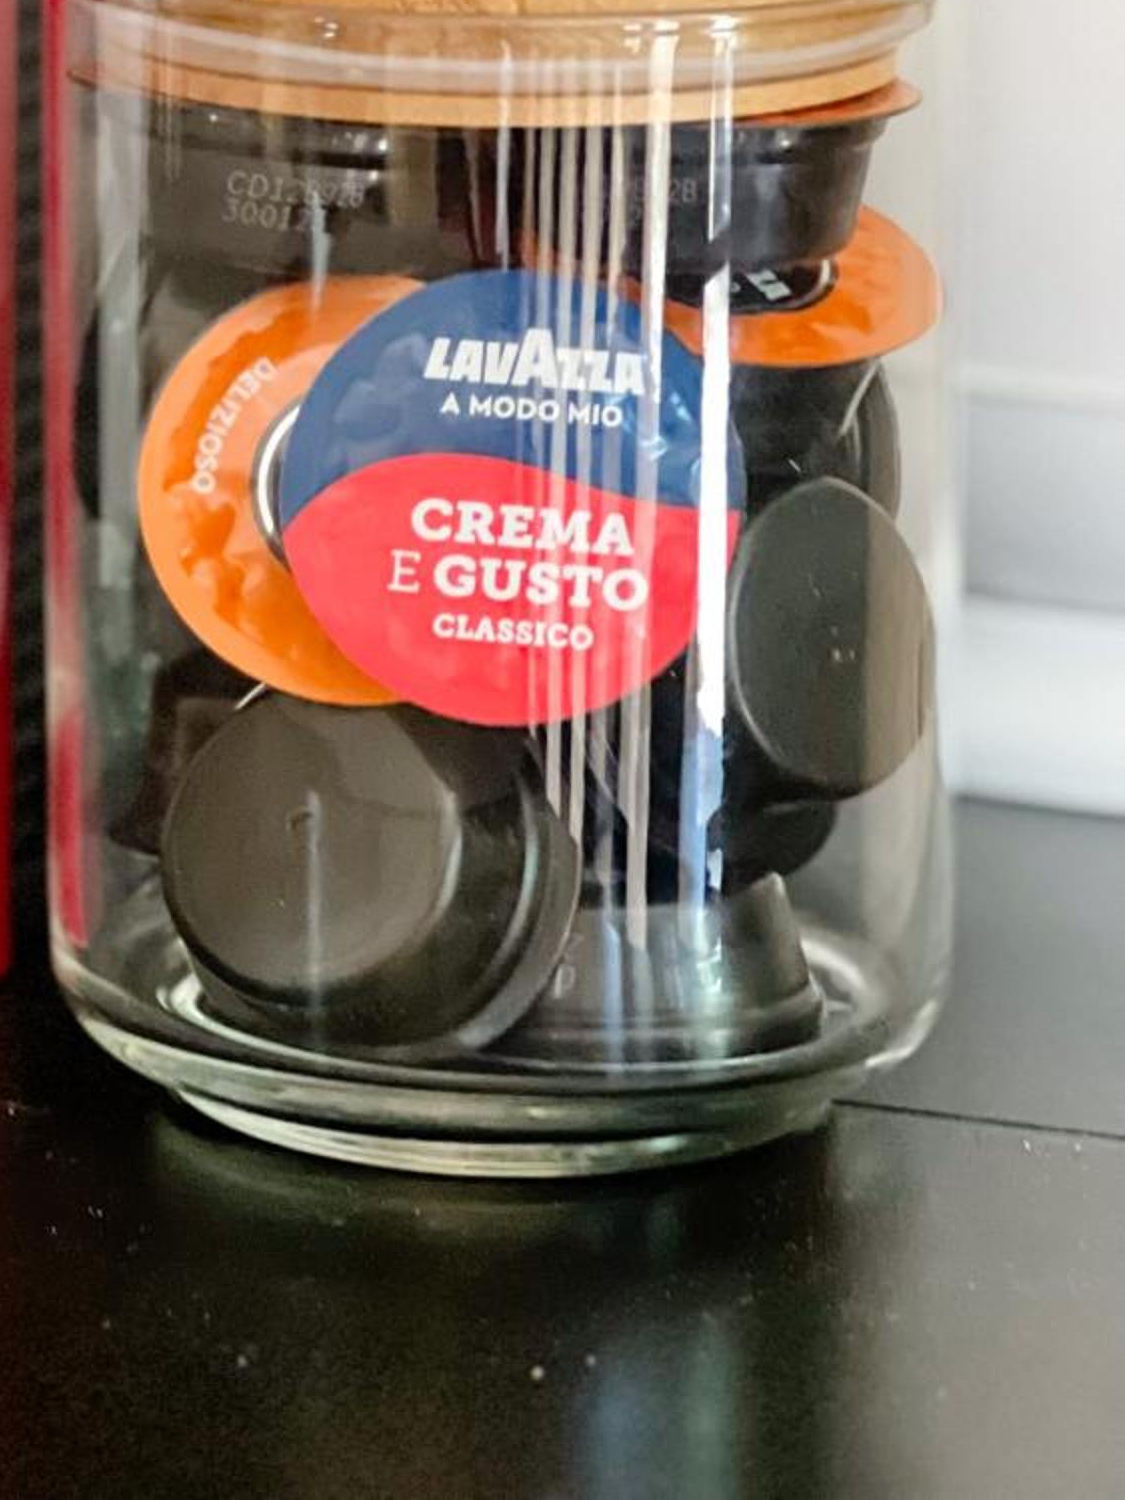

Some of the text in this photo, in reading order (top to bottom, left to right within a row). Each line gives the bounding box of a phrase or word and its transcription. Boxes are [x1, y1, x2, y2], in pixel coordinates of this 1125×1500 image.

[423, 327, 646, 396] LAVAZZA
[191, 357, 278, 495] DELIZIOSO
[439, 392, 624, 428] A MODO MIO
[411, 497, 635, 556] CREMA
[387, 548, 649, 612] E GUSTO
[432, 612, 595, 651] CLASSICO
